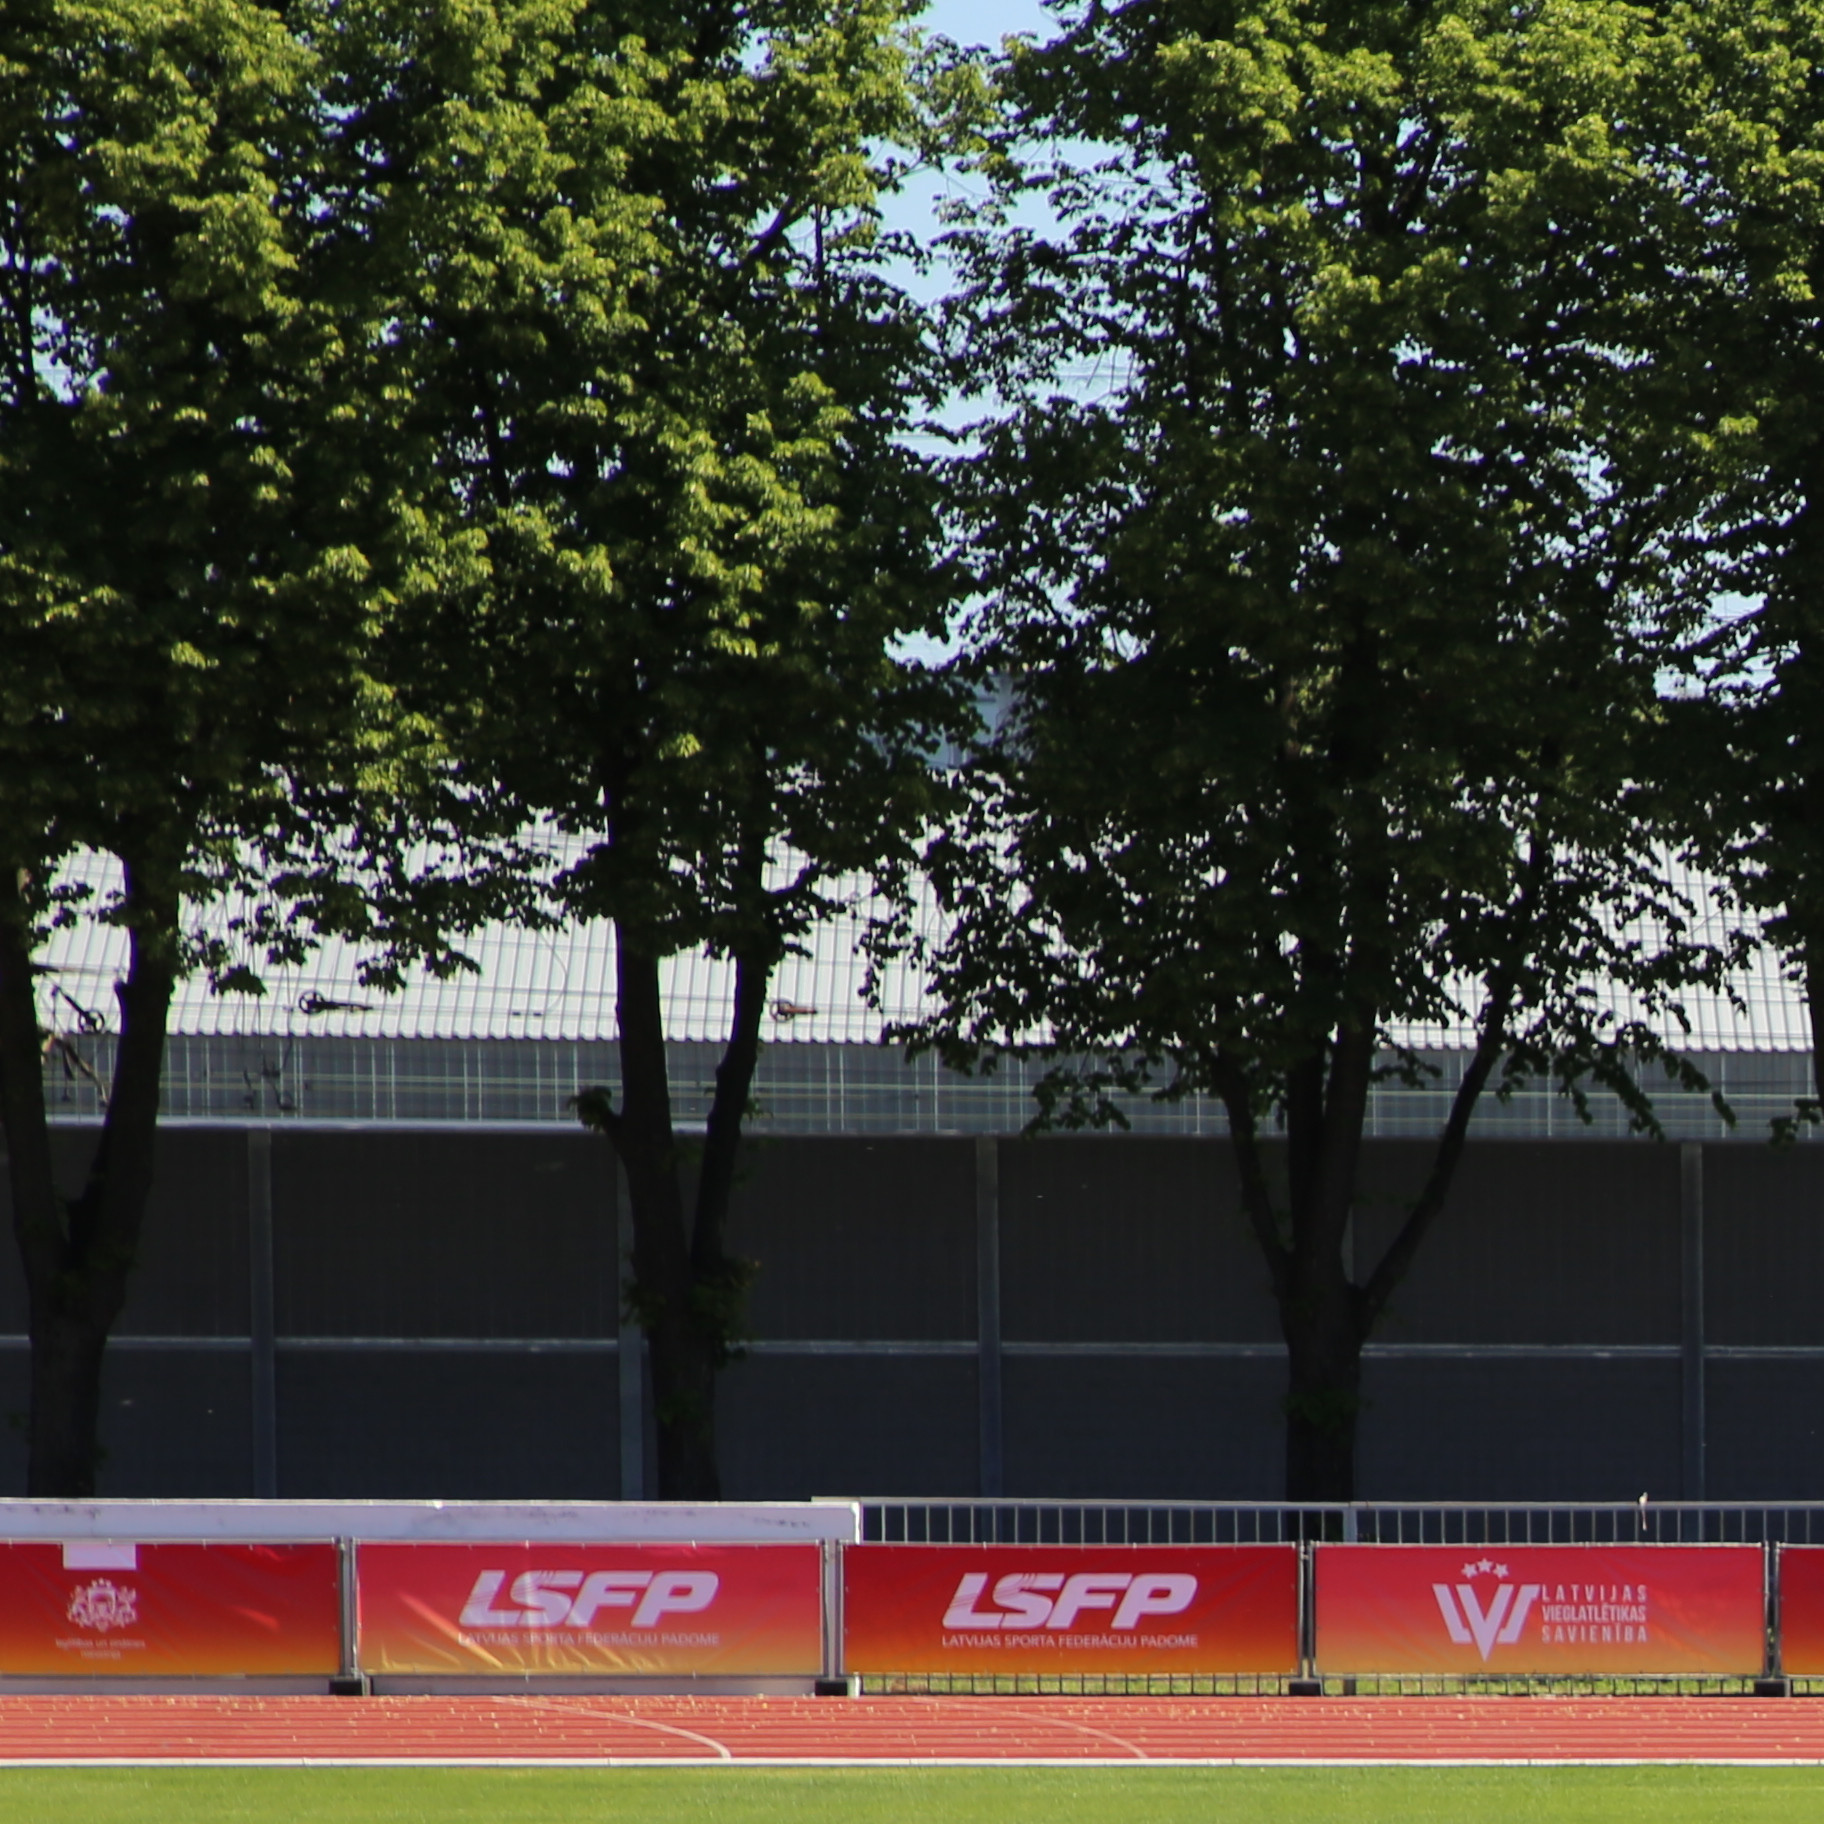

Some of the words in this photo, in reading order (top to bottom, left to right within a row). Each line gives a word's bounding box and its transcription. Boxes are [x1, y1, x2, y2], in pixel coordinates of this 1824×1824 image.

[458, 1569, 720, 1627] LSFP
[942, 1572, 1199, 1629] LSFP
[1541, 1584, 1647, 1603] LATVIJAS
[1541, 1602, 1647, 1622] VIEGLATLĒTIKAS
[1541, 1623, 1648, 1644] SAVIENĪBA
